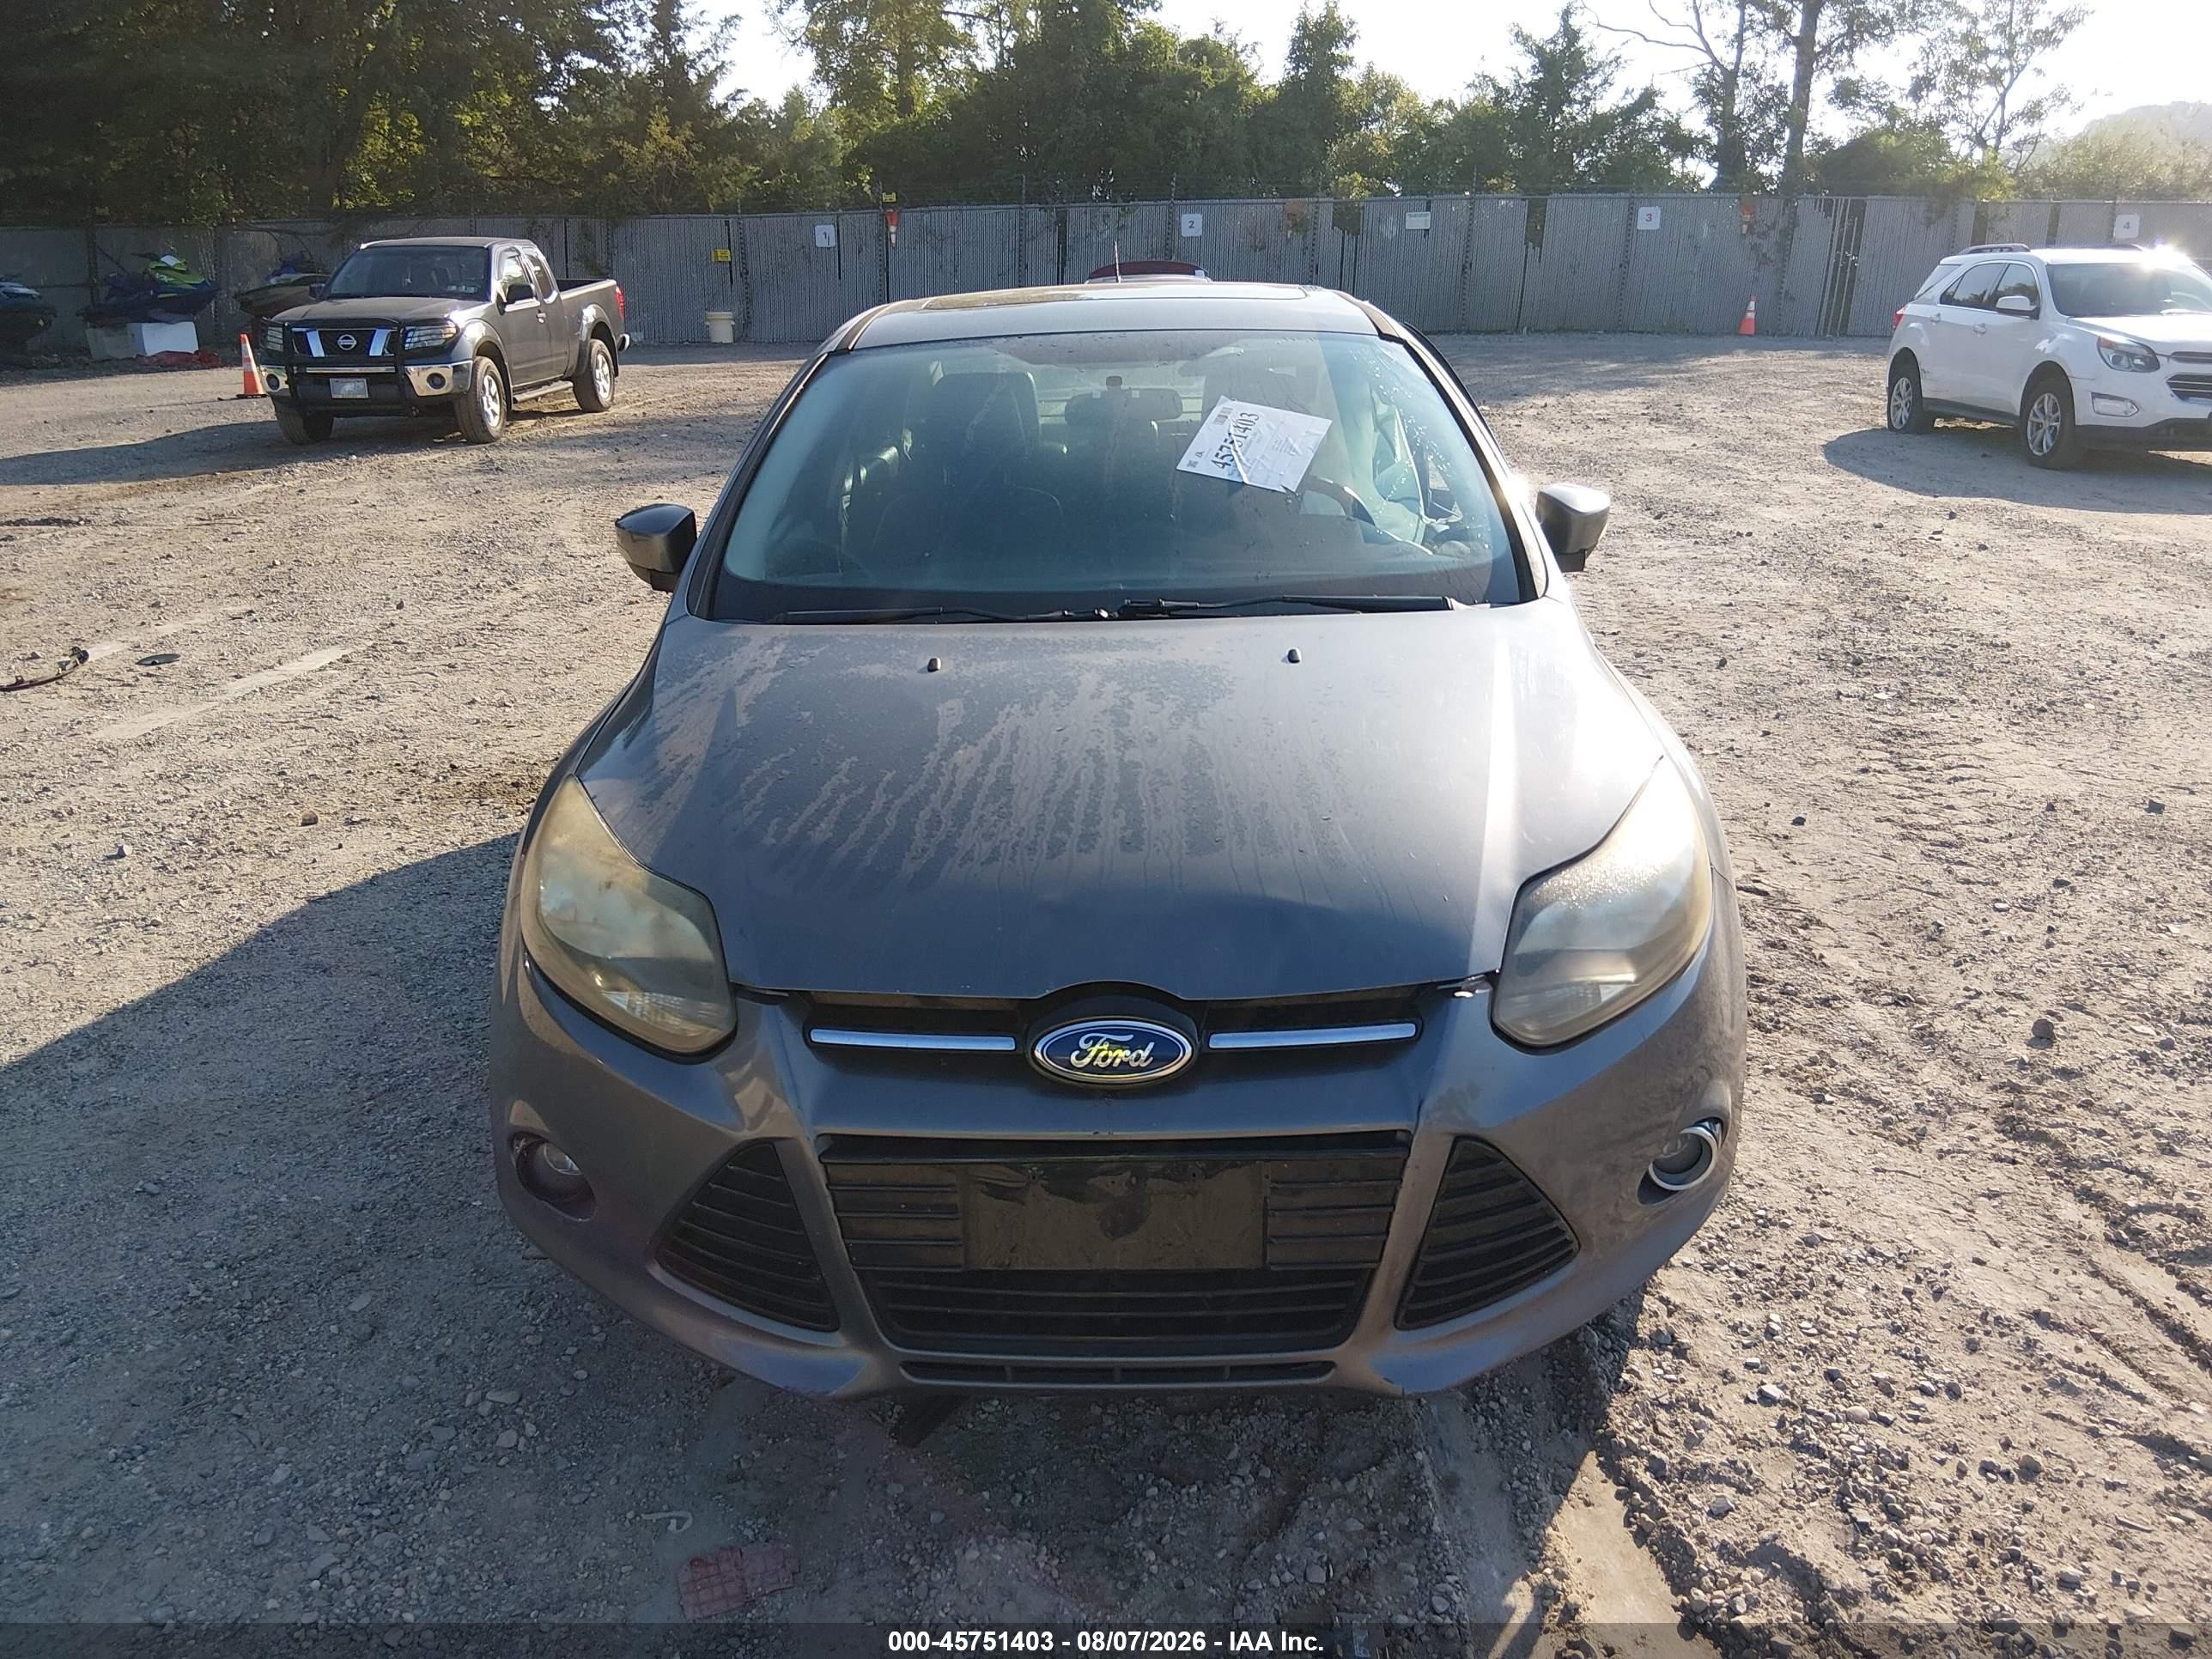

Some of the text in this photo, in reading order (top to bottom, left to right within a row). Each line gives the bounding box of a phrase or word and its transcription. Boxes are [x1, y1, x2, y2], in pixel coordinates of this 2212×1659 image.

[1645, 213, 1652, 222] 3
[1188, 220, 1195, 229] 2
[1070, 1032, 1155, 1068] Ford
